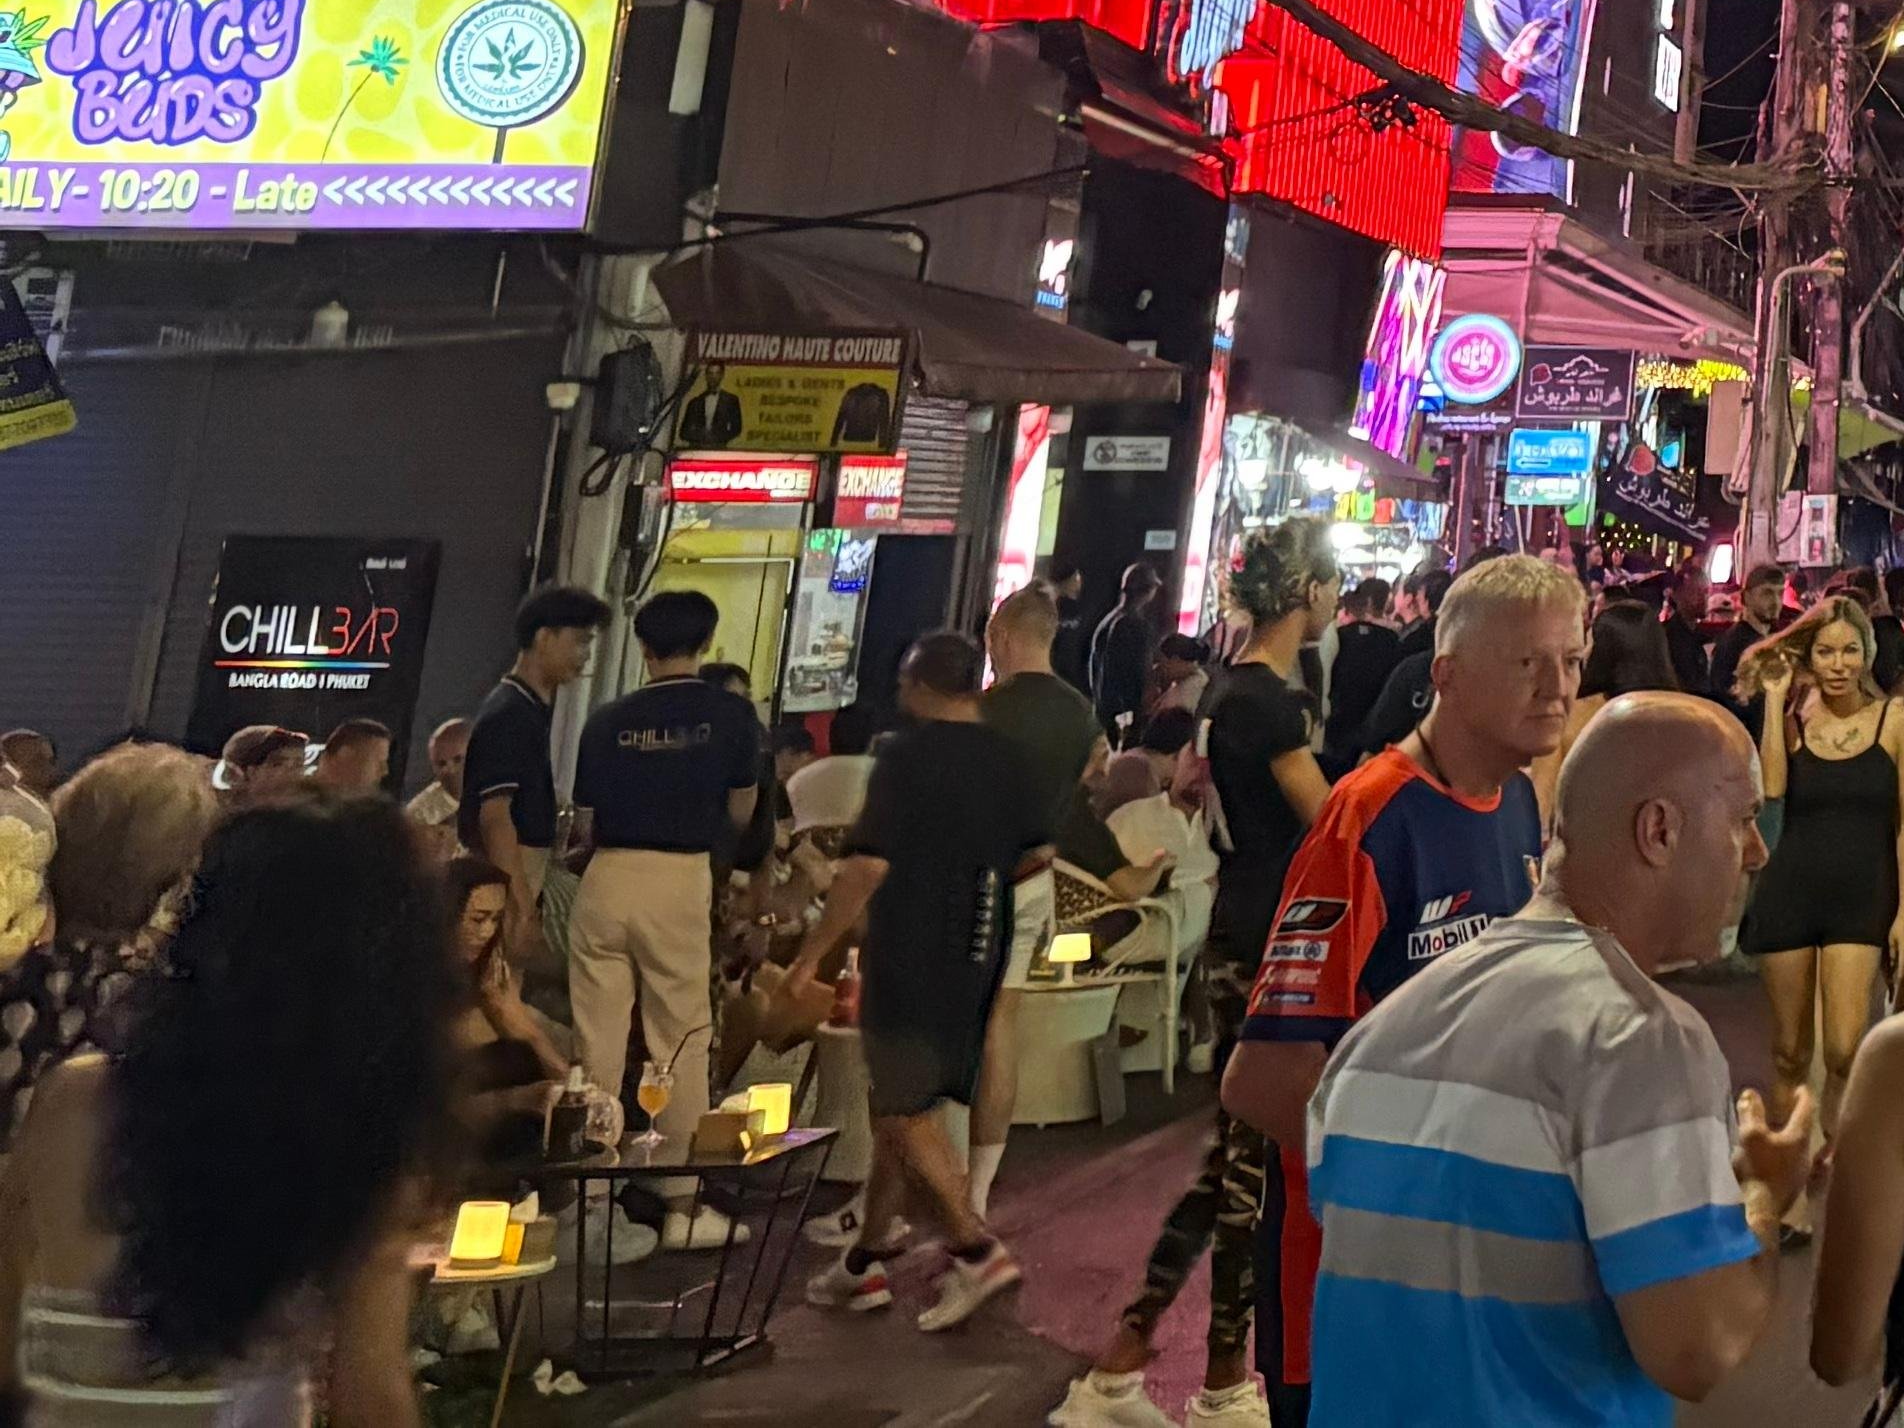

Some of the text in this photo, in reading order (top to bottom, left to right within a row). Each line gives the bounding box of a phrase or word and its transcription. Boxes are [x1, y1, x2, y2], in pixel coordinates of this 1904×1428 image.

[99, 168, 201, 213] 10:20
[232, 169, 320, 213] Late
[699, 332, 781, 359] VALENTINO
[783, 335, 831, 361] HAUTE
[671, 467, 812, 491] EXCHANGE
[840, 466, 905, 498] EXCHANGE
[228, 672, 279, 689] BANGLA
[280, 673, 317, 690] ROAD
[326, 674, 371, 690] PHUKET
[1411, 922, 1469, 957] Mobil
